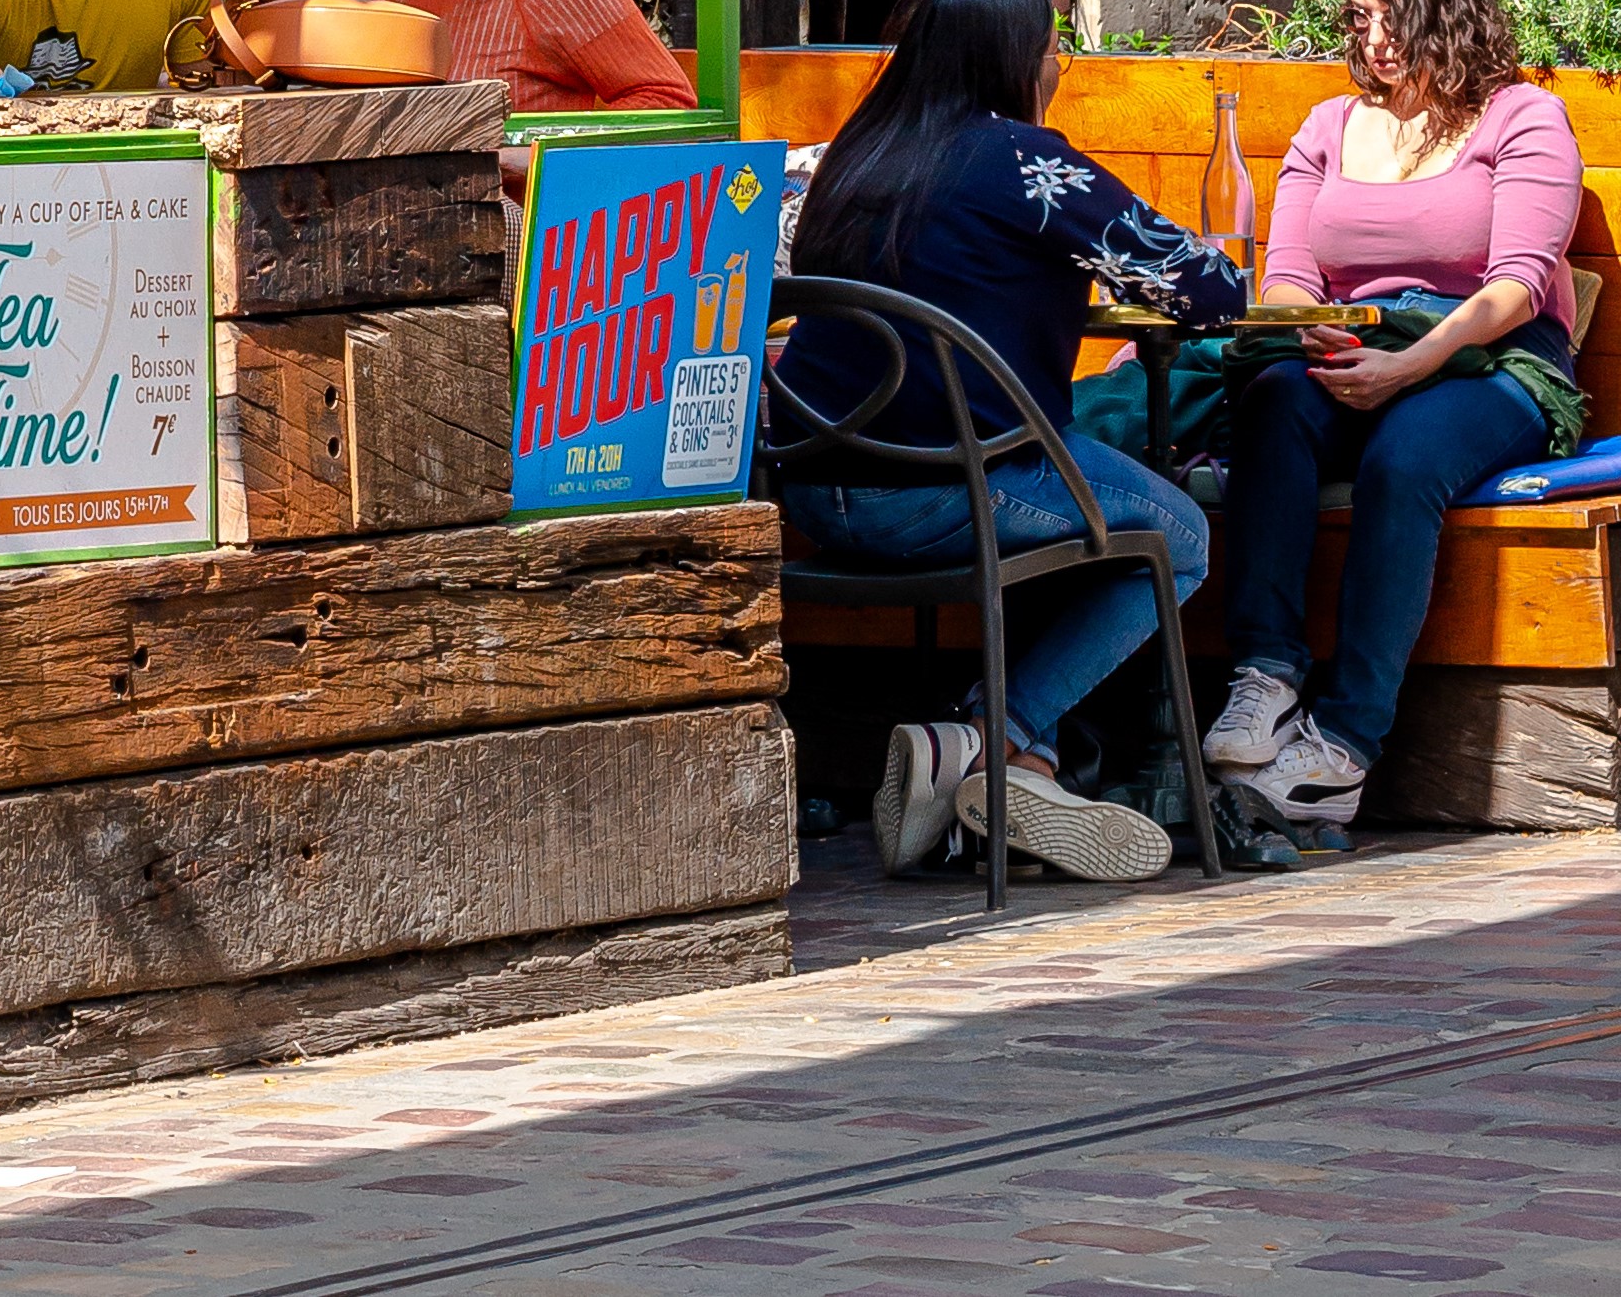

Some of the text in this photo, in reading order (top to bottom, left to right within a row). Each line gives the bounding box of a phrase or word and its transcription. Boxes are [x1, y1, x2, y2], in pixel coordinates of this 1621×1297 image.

[12, 202, 24, 225] A
[29, 201, 63, 224] CUP
[68, 201, 91, 223] OF
[97, 199, 125, 221] TEA
[131, 199, 142, 220] &
[147, 197, 188, 219] CAKE
[534, 164, 725, 338] HAPPY
[135, 268, 193, 295] DESSERT
[130, 298, 197, 320] AU CHOIX
[131, 354, 196, 380] BOISSON
[518, 293, 676, 459] HOUR
[676, 362, 728, 398] PINTES
[135, 383, 191, 404] CHAUDE
[672, 398, 736, 428] COCKTAILS
[669, 430, 678, 454] &
[681, 426, 710, 454] GINS
[13, 505, 51, 528] TOUS
[54, 504, 74, 525] LES
[76, 499, 121, 523] JOURS
